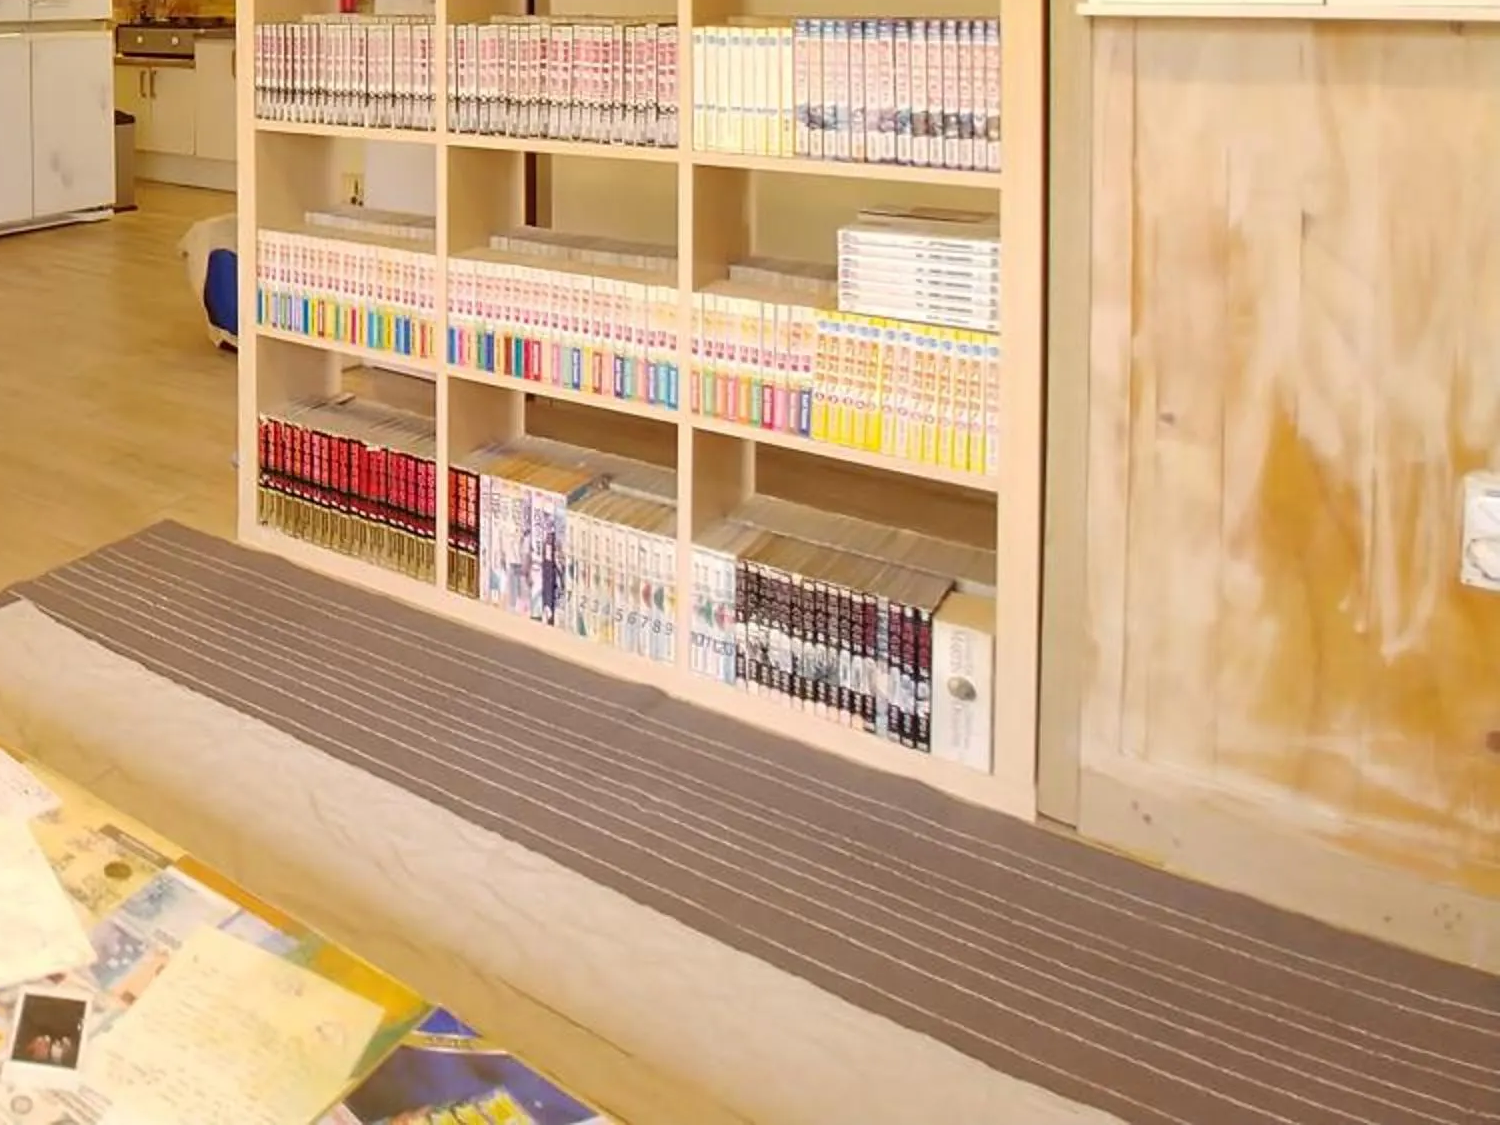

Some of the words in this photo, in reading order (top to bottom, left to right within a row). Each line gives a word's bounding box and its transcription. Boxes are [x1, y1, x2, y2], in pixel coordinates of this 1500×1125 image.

[615, 608, 624, 623] 5
[627, 611, 637, 626] 6
[640, 615, 649, 628] 7
[652, 620, 662, 634] 8
[664, 622, 674, 636] 9
